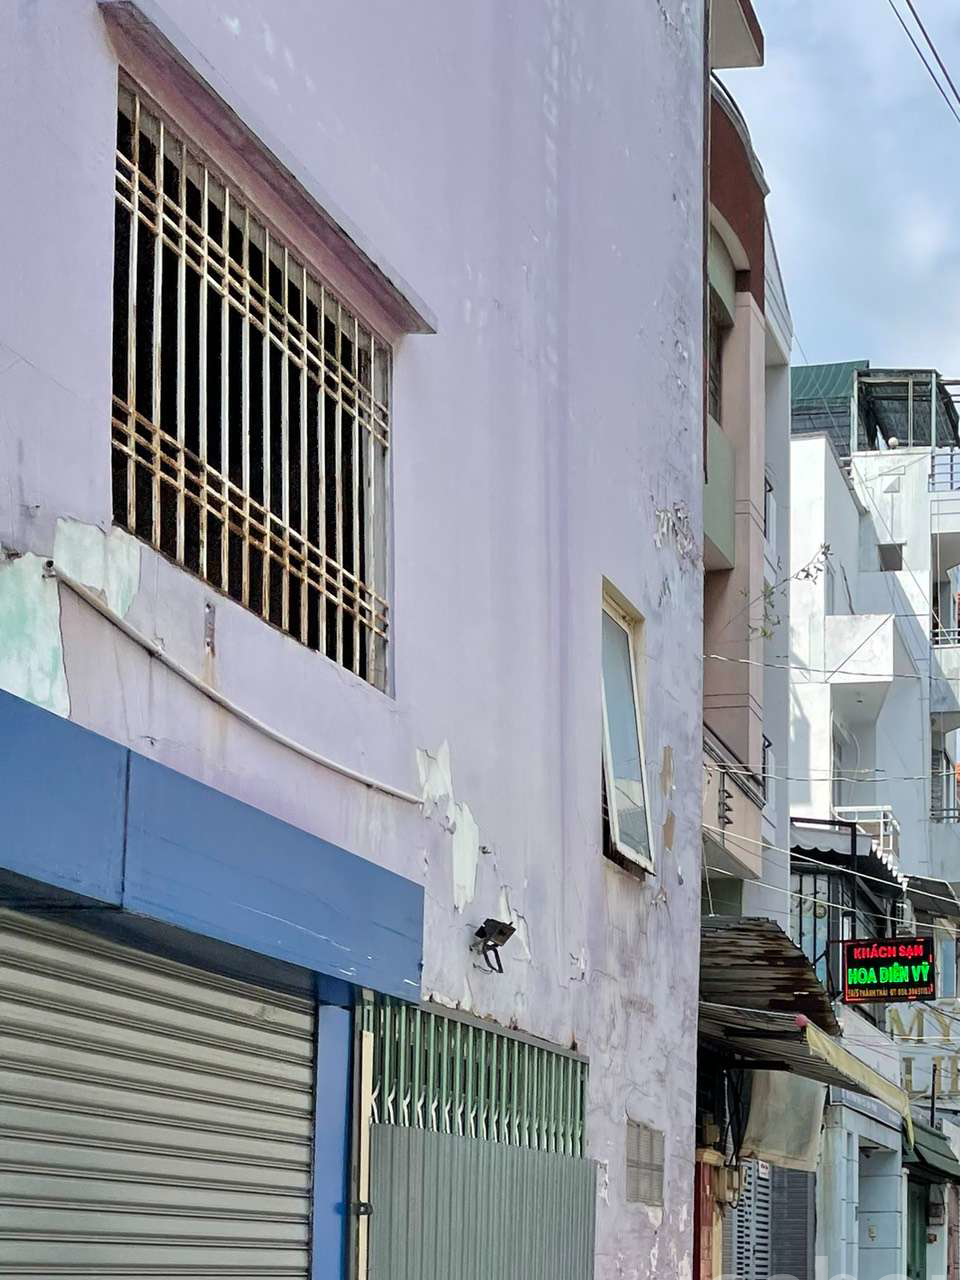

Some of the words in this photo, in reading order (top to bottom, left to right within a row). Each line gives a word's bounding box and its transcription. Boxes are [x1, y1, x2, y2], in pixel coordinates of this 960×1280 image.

[853, 943, 897, 959] KHÁCH
[898, 944, 924, 959] SẠN
[847, 967, 878, 985] HOA
[879, 961, 909, 983] DIÊN
[911, 960, 930, 982] VỸ
